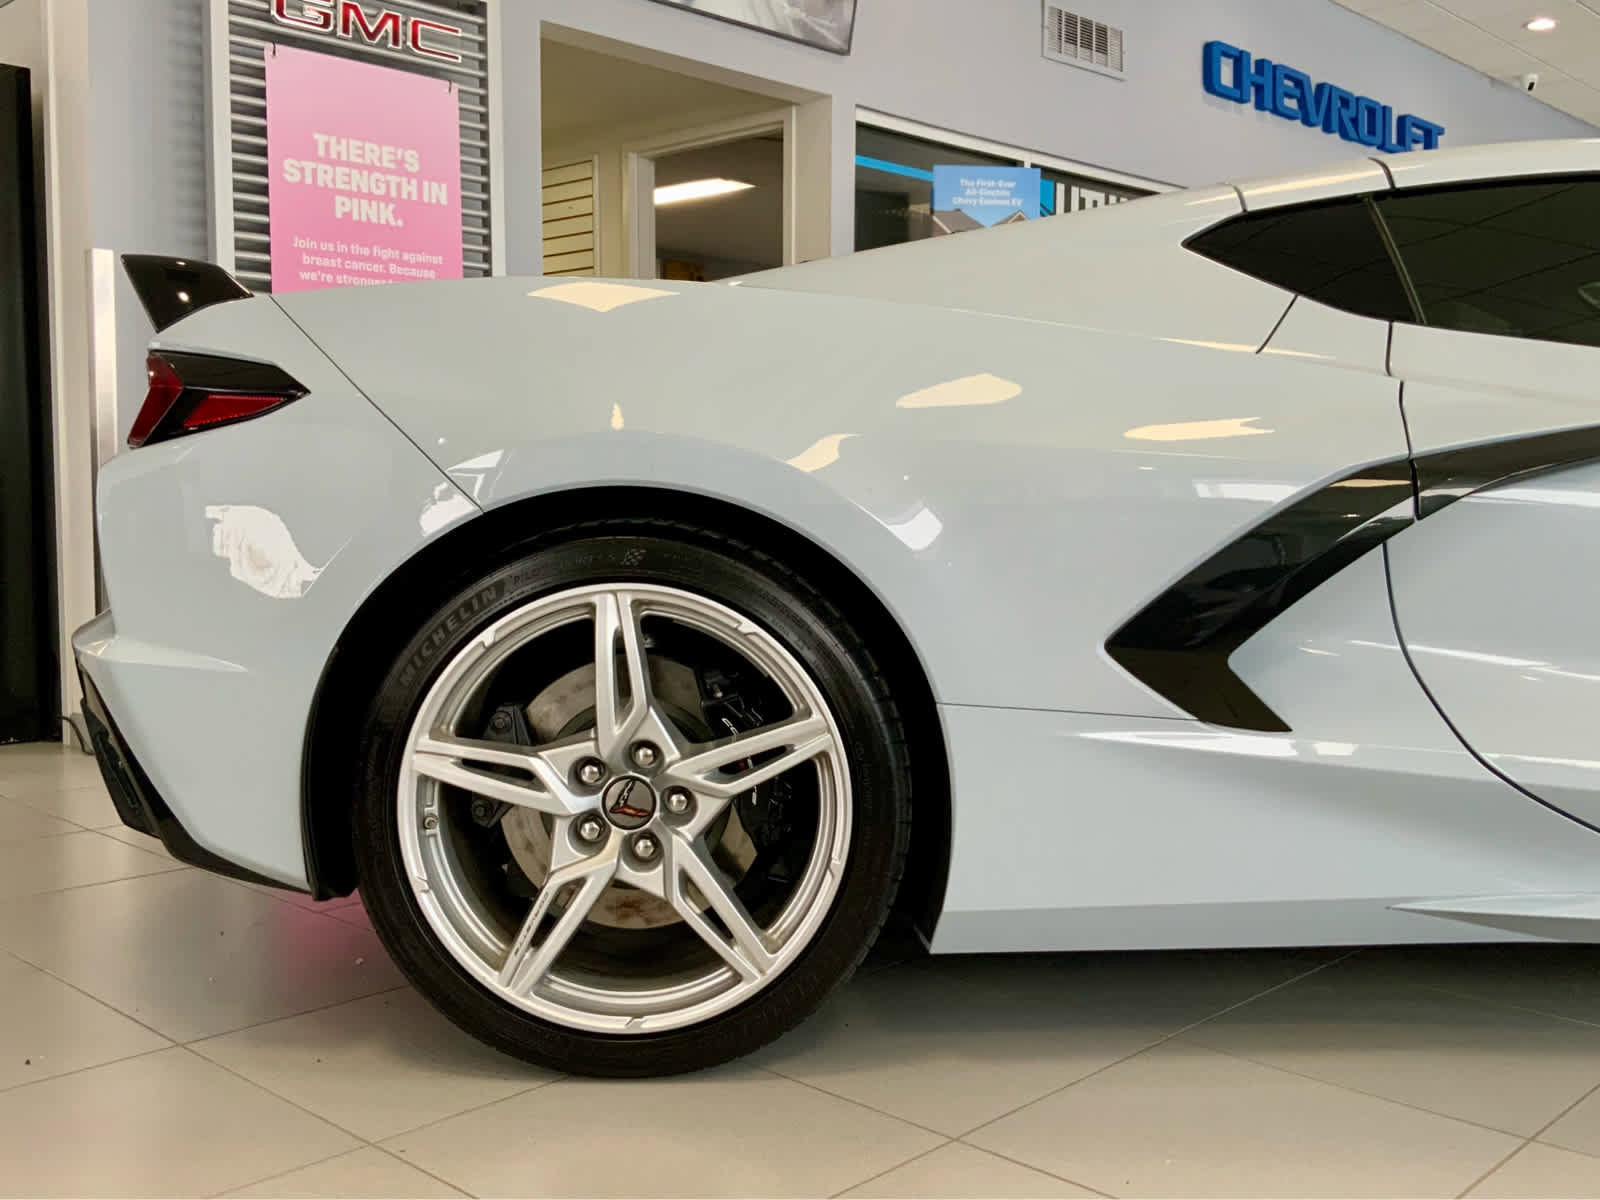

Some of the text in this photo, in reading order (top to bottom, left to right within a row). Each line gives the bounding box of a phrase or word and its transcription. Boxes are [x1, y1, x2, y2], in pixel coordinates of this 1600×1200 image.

[270, 0, 462, 63] GMC
[1202, 39, 1445, 154] CHEVROLET
[314, 134, 419, 172] THERE'S
[282, 158, 448, 205] STRENGTH IN
[334, 196, 403, 227] PINK.
[293, 237, 444, 265] Join us in the fight against
[302, 253, 436, 279] breast cancer. Because
[298, 270, 334, 283] we're
[399, 586, 499, 687] MICHELIN
